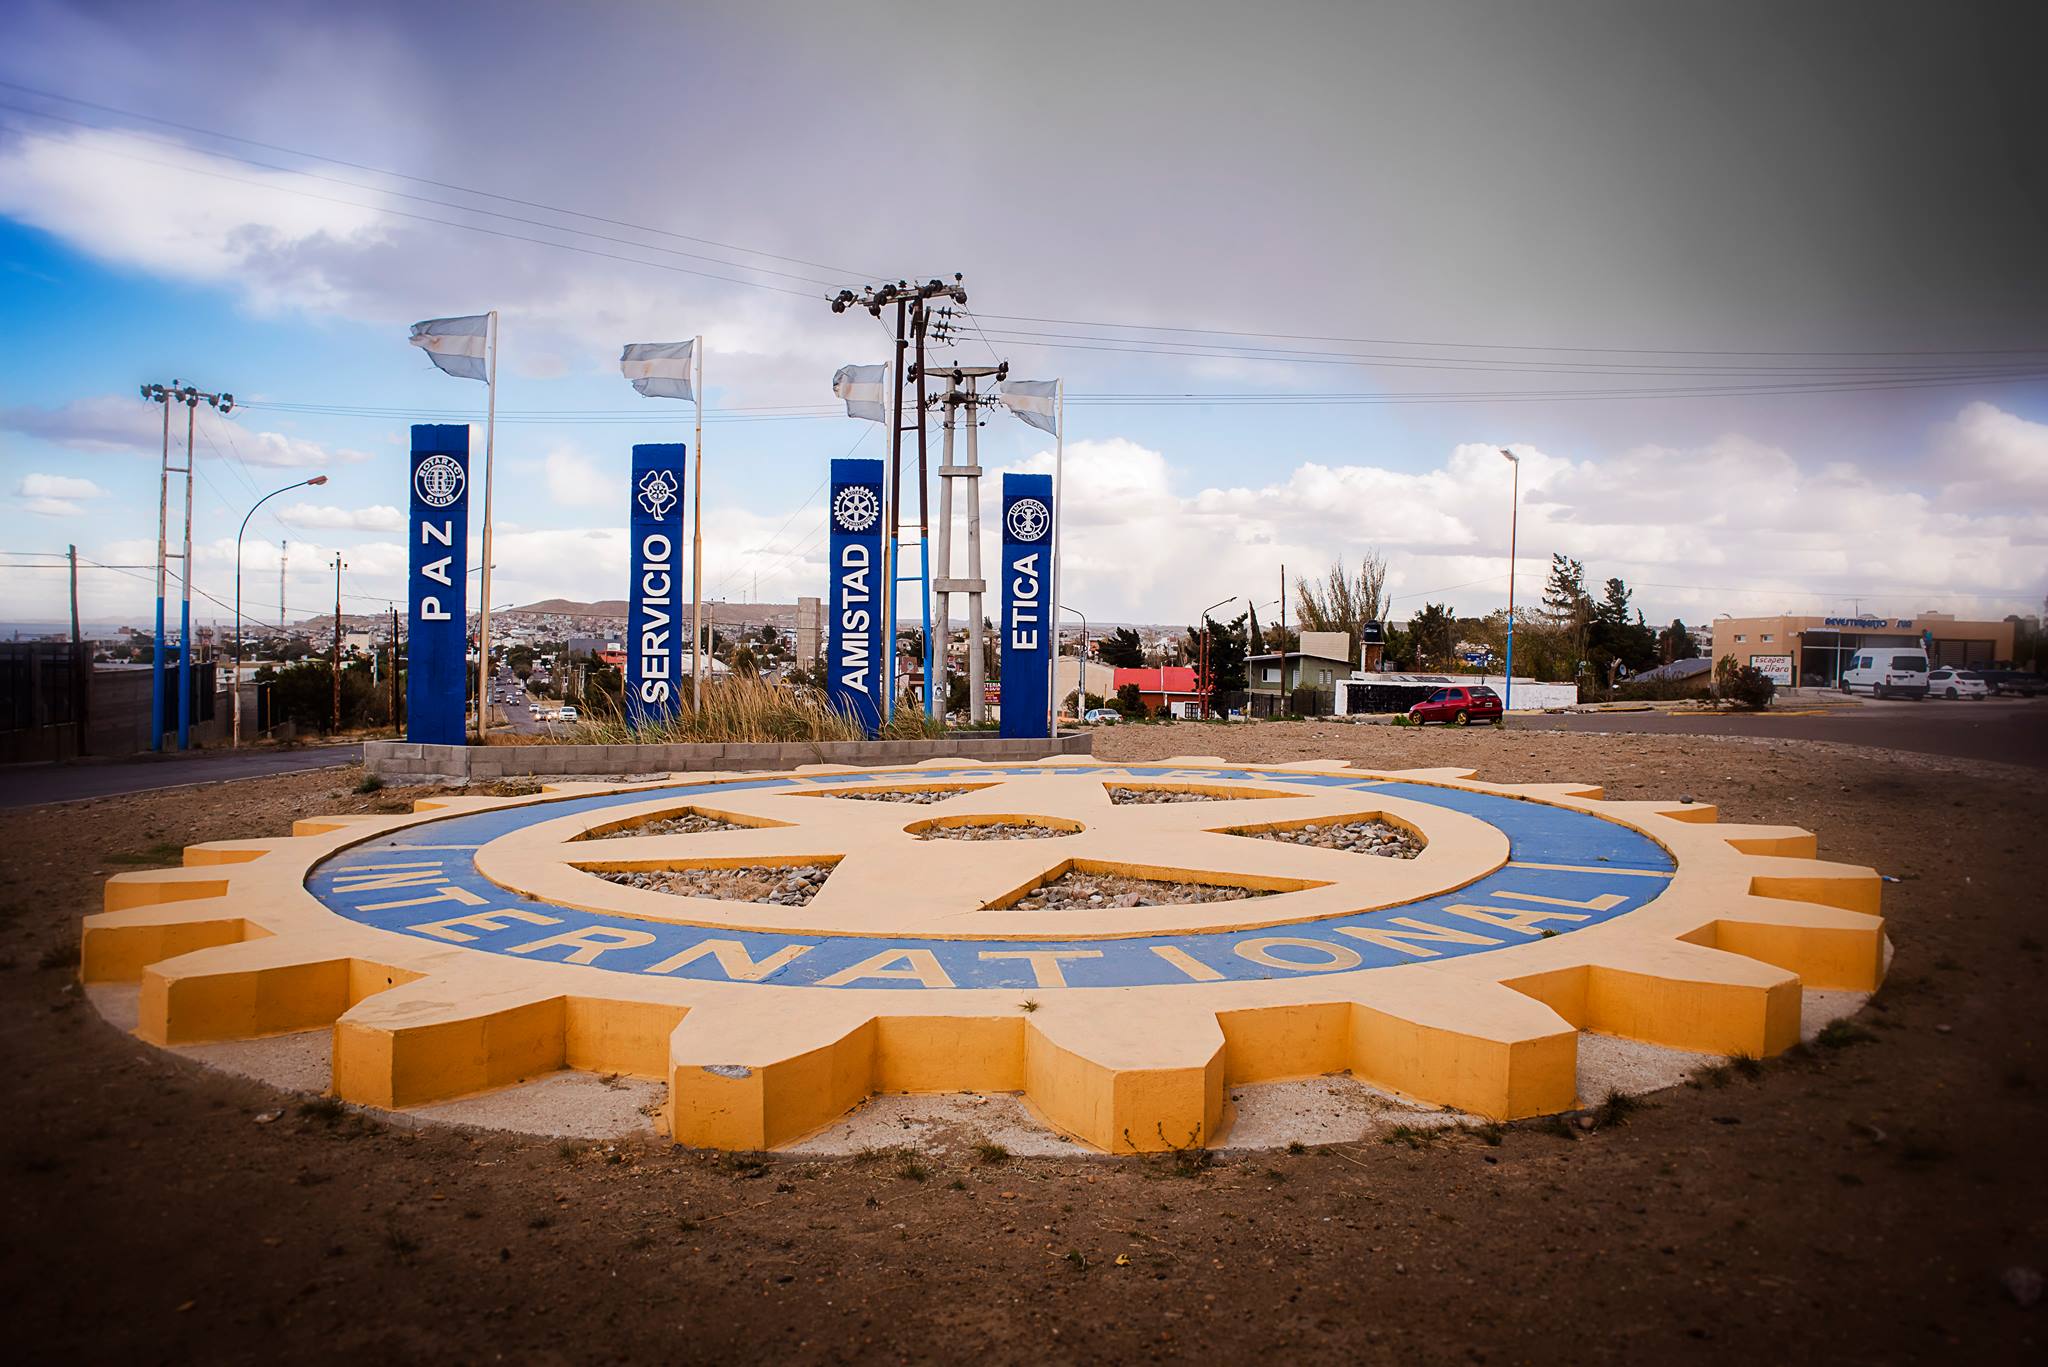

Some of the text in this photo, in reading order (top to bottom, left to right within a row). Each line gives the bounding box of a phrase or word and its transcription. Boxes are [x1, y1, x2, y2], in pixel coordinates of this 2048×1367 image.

[419, 457, 463, 480] ROTARACT
[426, 494, 454, 504] CLUB
[421, 520, 453, 621] PAZ
[641, 533, 672, 704] SERVICIO
[841, 543, 870, 694] AMISTAD
[1012, 552, 1039, 650] ETICA
[1755, 657, 1786, 665] Escapes
[333, 860, 1629, 989] INTERNATIONAL
